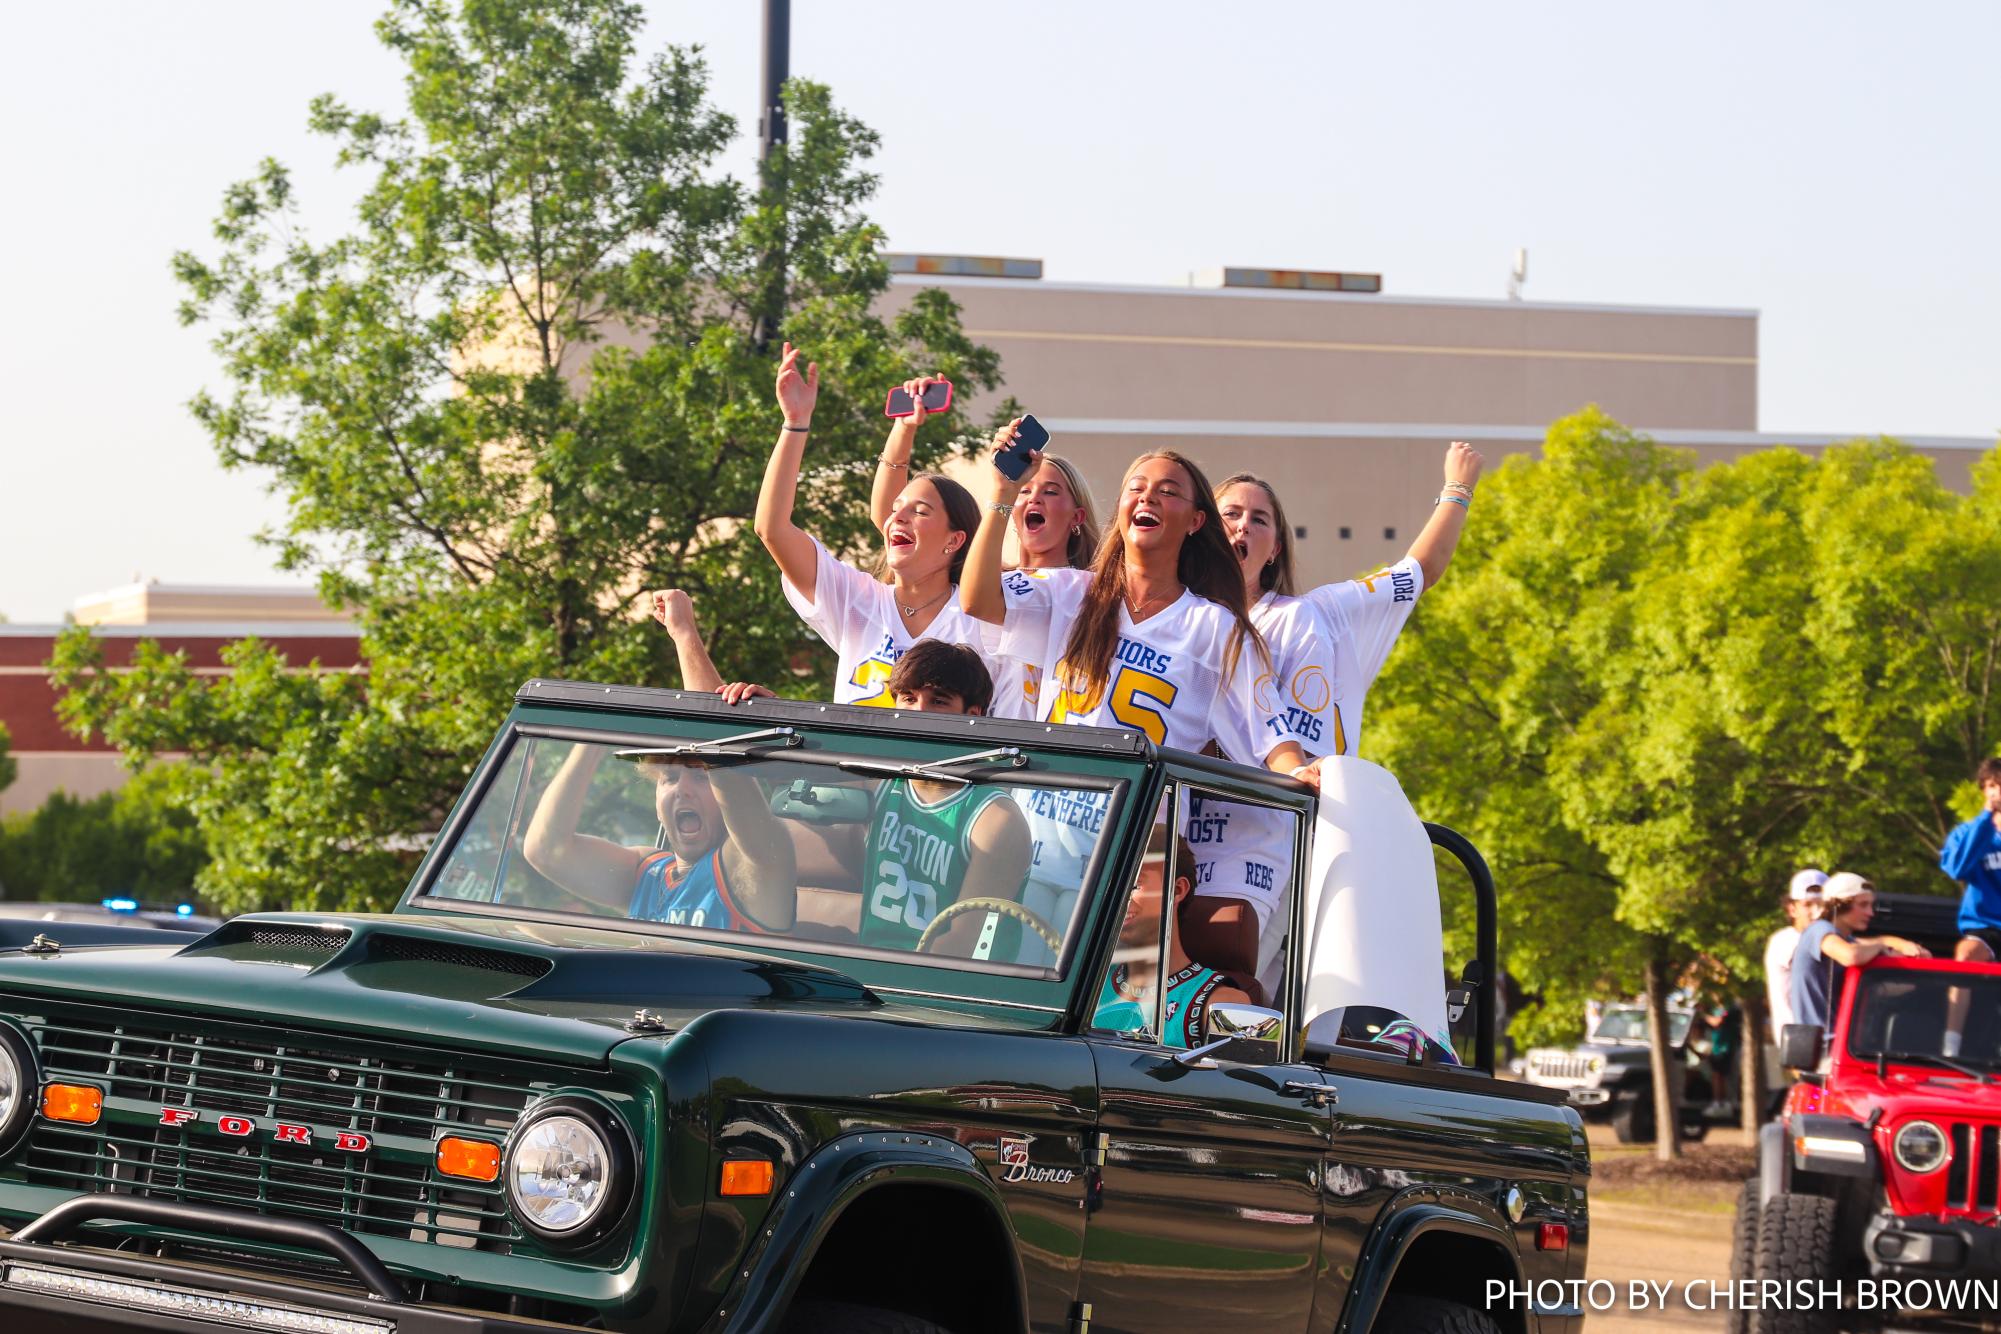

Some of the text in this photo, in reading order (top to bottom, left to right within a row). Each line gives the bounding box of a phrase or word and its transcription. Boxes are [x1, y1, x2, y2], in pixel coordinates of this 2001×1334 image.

[1391, 567, 1414, 603] PROV.
[1116, 637, 1172, 674] IORS
[1187, 819, 1228, 844] OST
[1245, 862, 1274, 891] REBS
[870, 860, 937, 931] 20
[159, 1107, 373, 1153] FORD
[1003, 1150, 1075, 1184] Bronco
